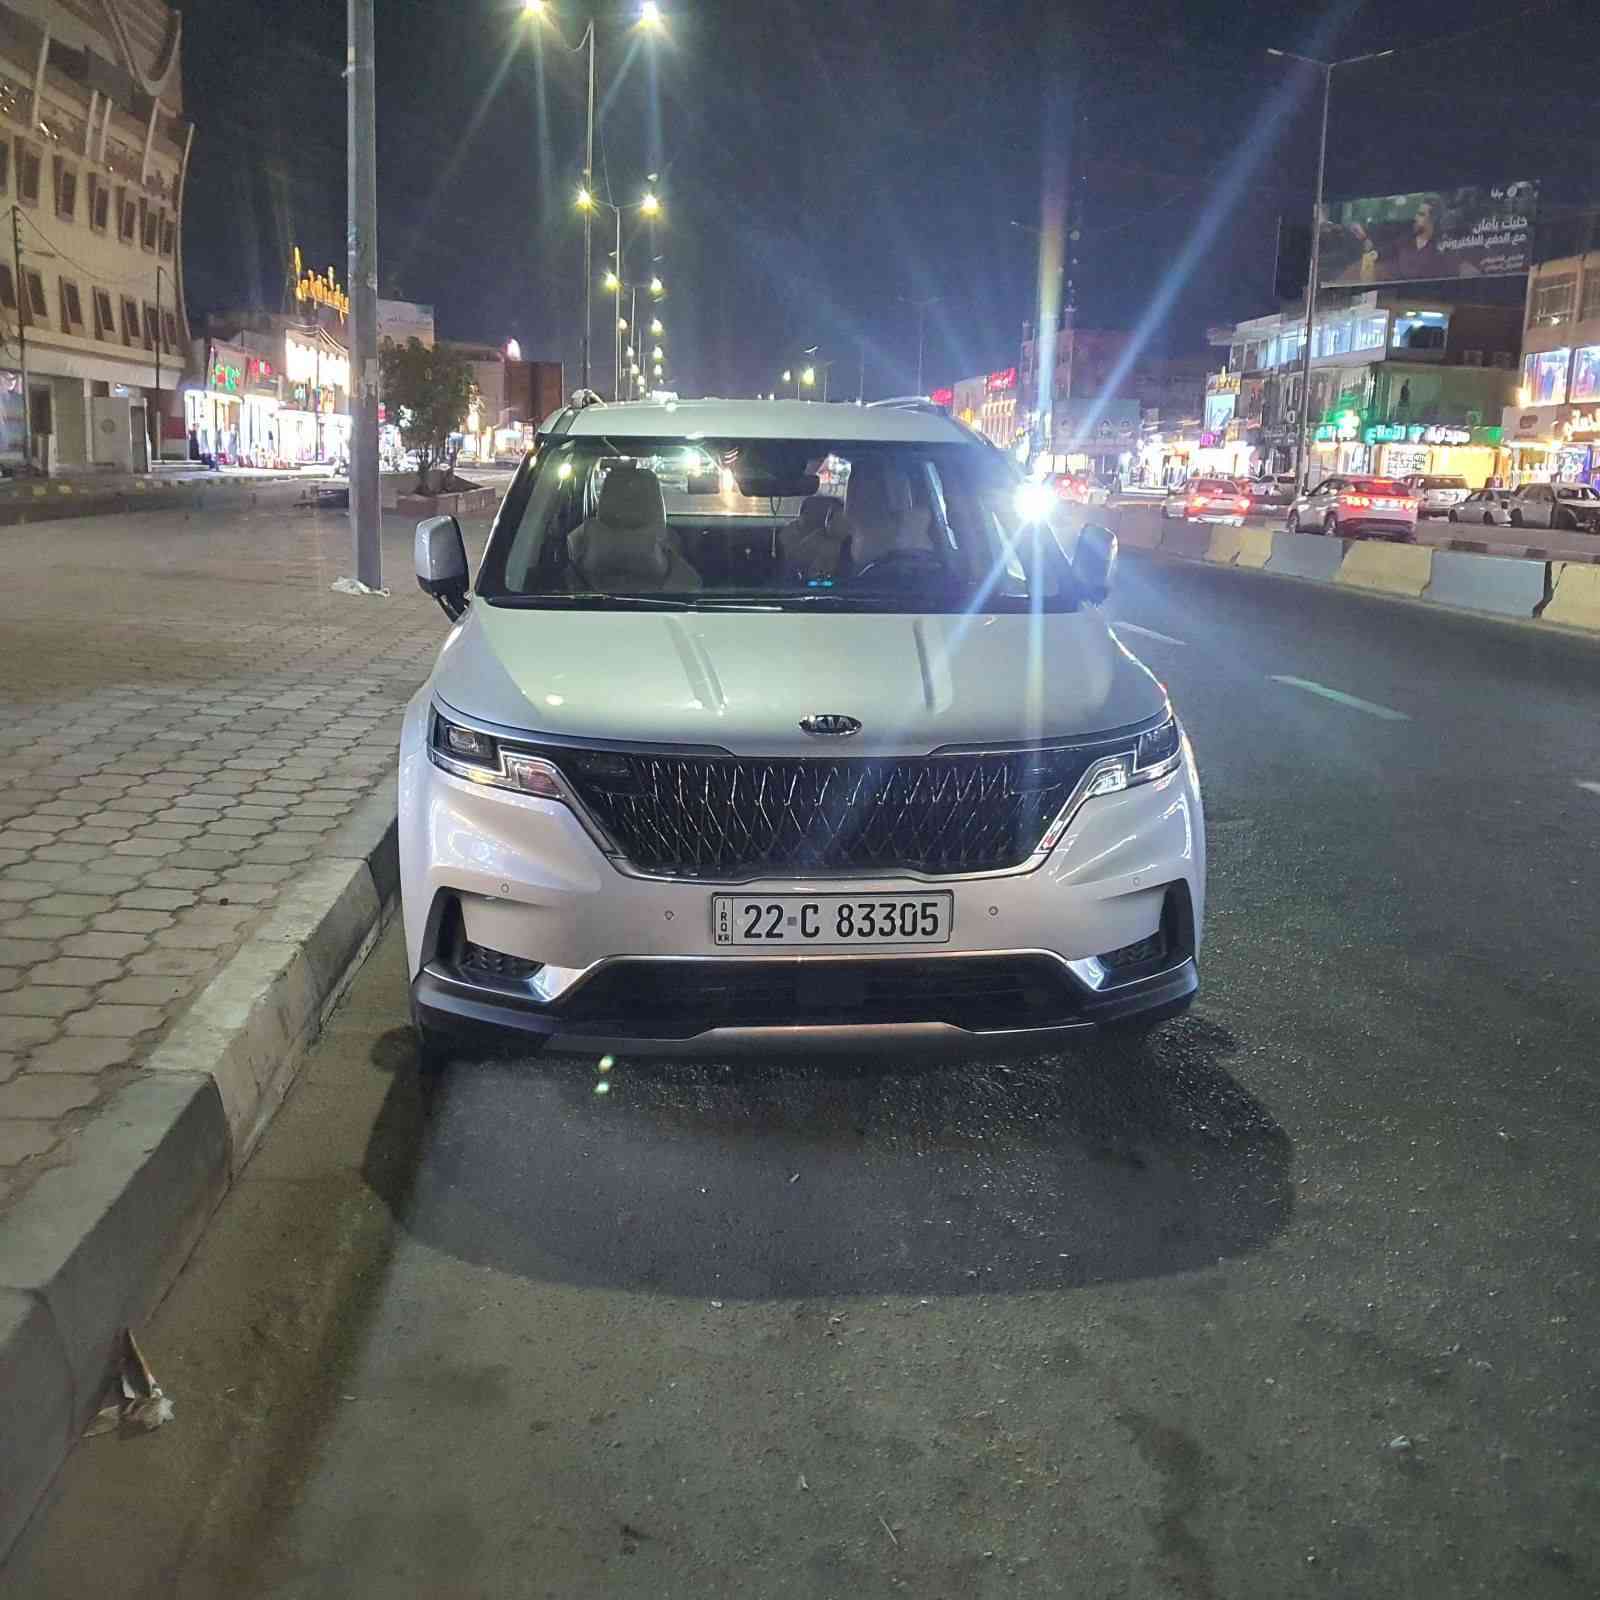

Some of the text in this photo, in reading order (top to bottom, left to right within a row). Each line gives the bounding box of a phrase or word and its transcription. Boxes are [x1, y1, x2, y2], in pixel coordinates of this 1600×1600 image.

[744, 902, 939, 938] 22 C 83305
